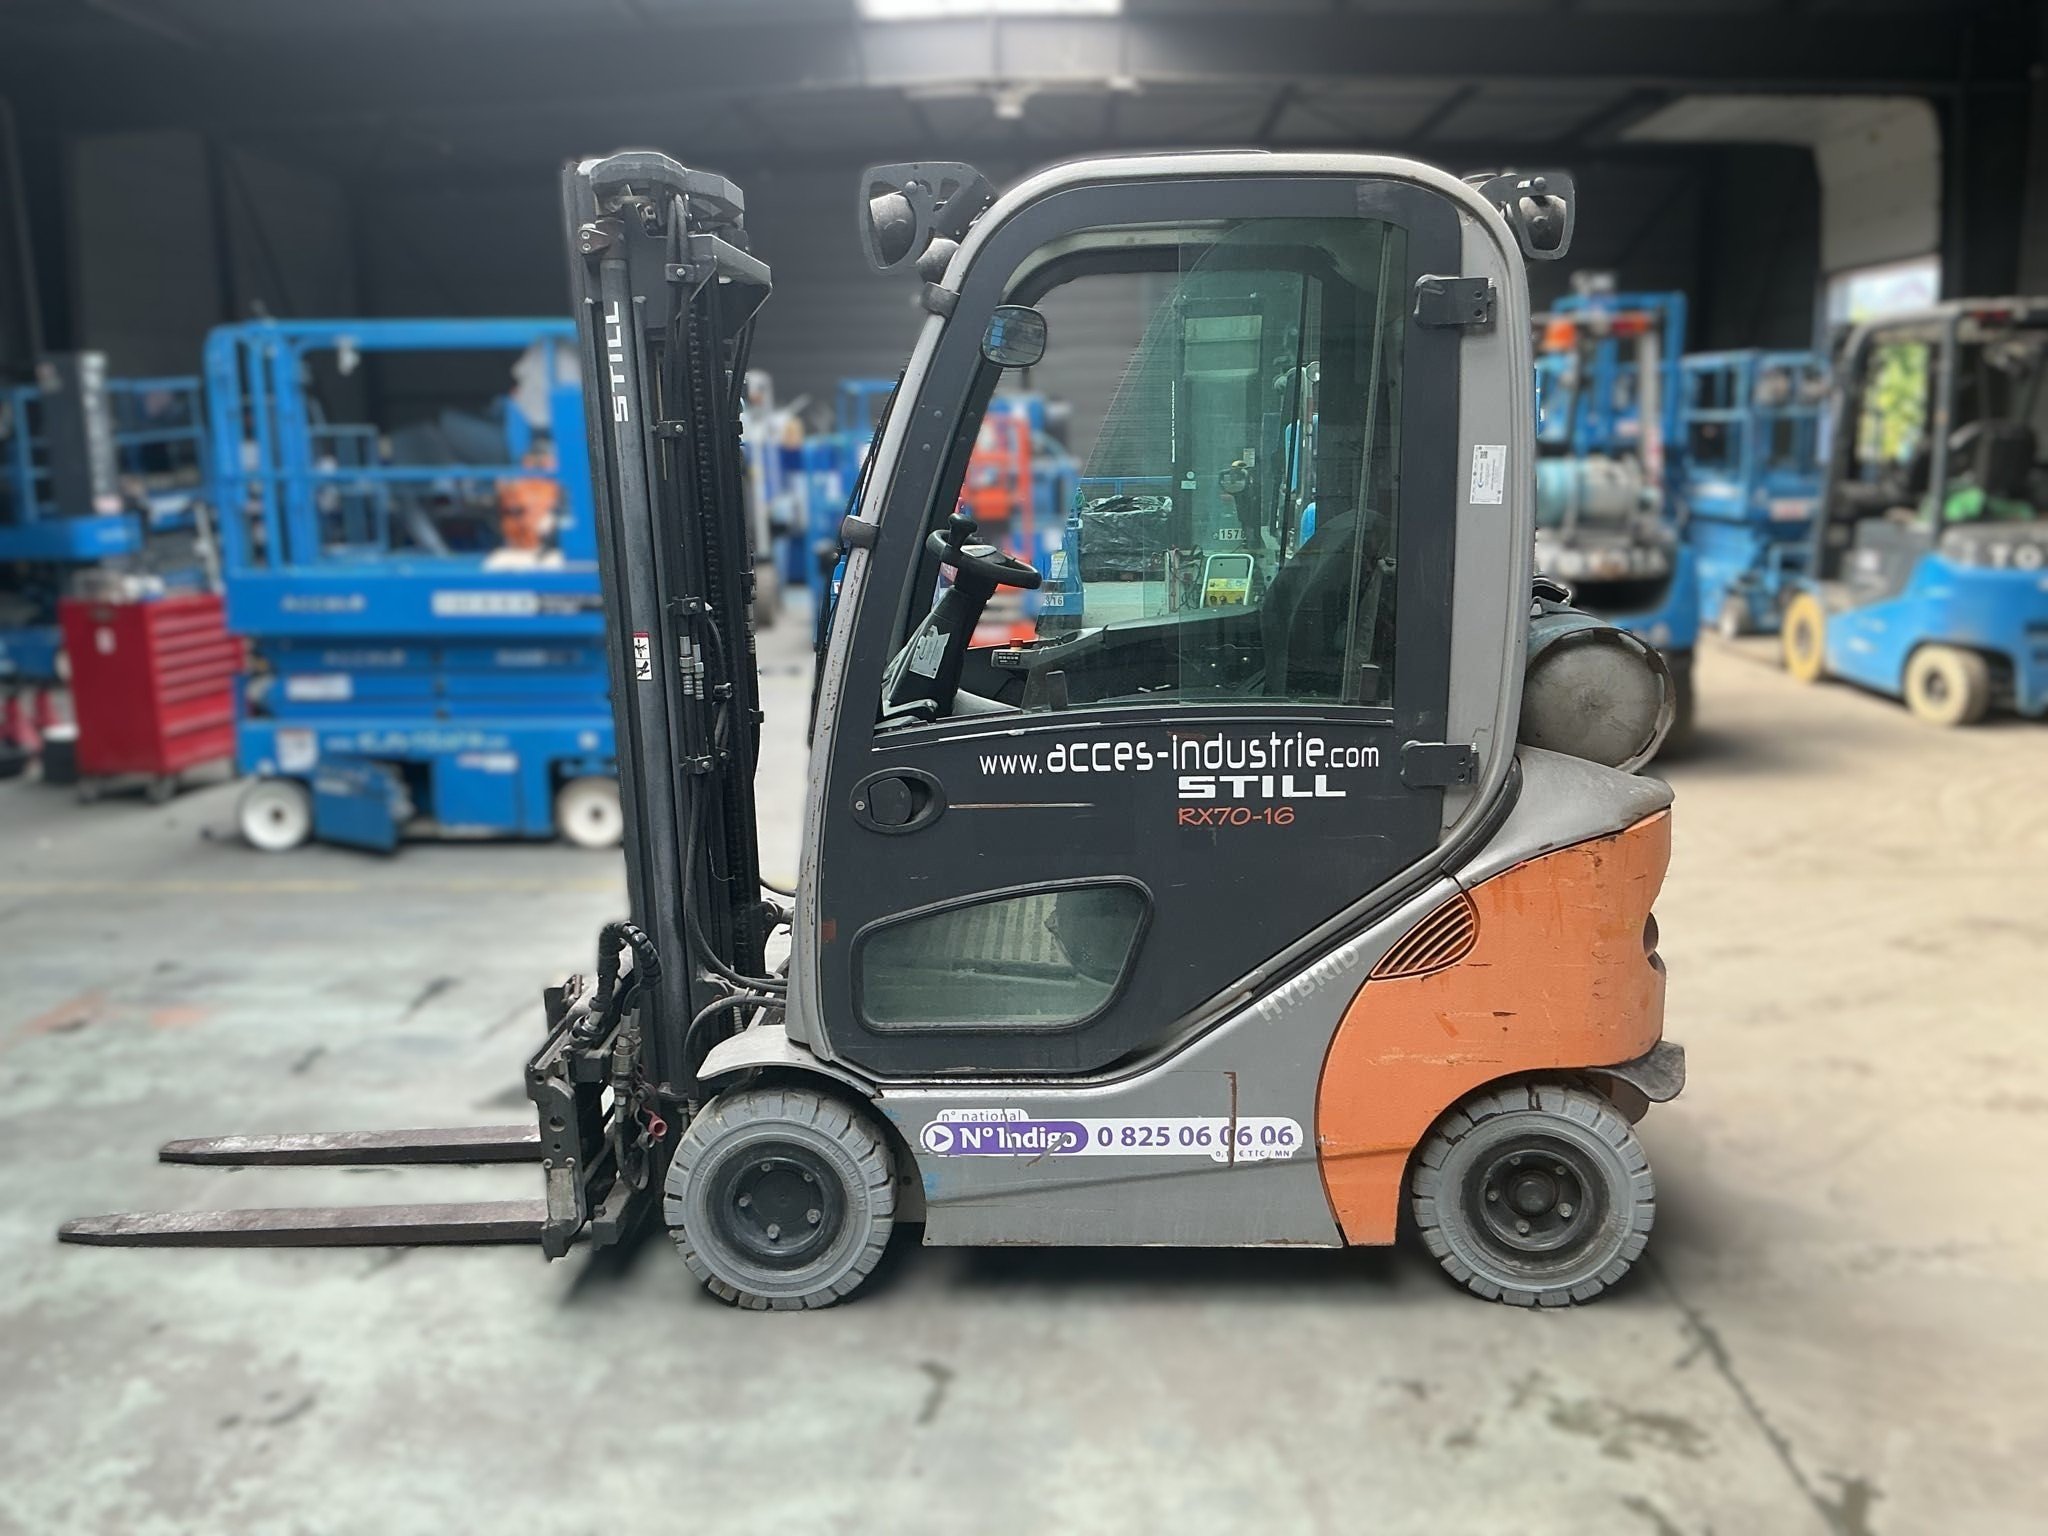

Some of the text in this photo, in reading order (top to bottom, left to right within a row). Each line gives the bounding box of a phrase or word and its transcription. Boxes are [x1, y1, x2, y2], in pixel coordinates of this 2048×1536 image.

[605, 301, 629, 423] STILL
[979, 731, 1380, 774] www.acces-industrie.com
[1178, 774, 1346, 799] STILL
[1178, 806, 1296, 826] RX70-16
[1256, 945, 1360, 1022] HYBRID
[941, 1110, 1021, 1121] n° national
[959, 1126, 994, 1149] N°
[996, 1126, 1077, 1151] Indigo
[1121, 1126, 1171, 1147] 825
[1178, 1125, 1212, 1147] 06
[1260, 1125, 1295, 1146] 06
